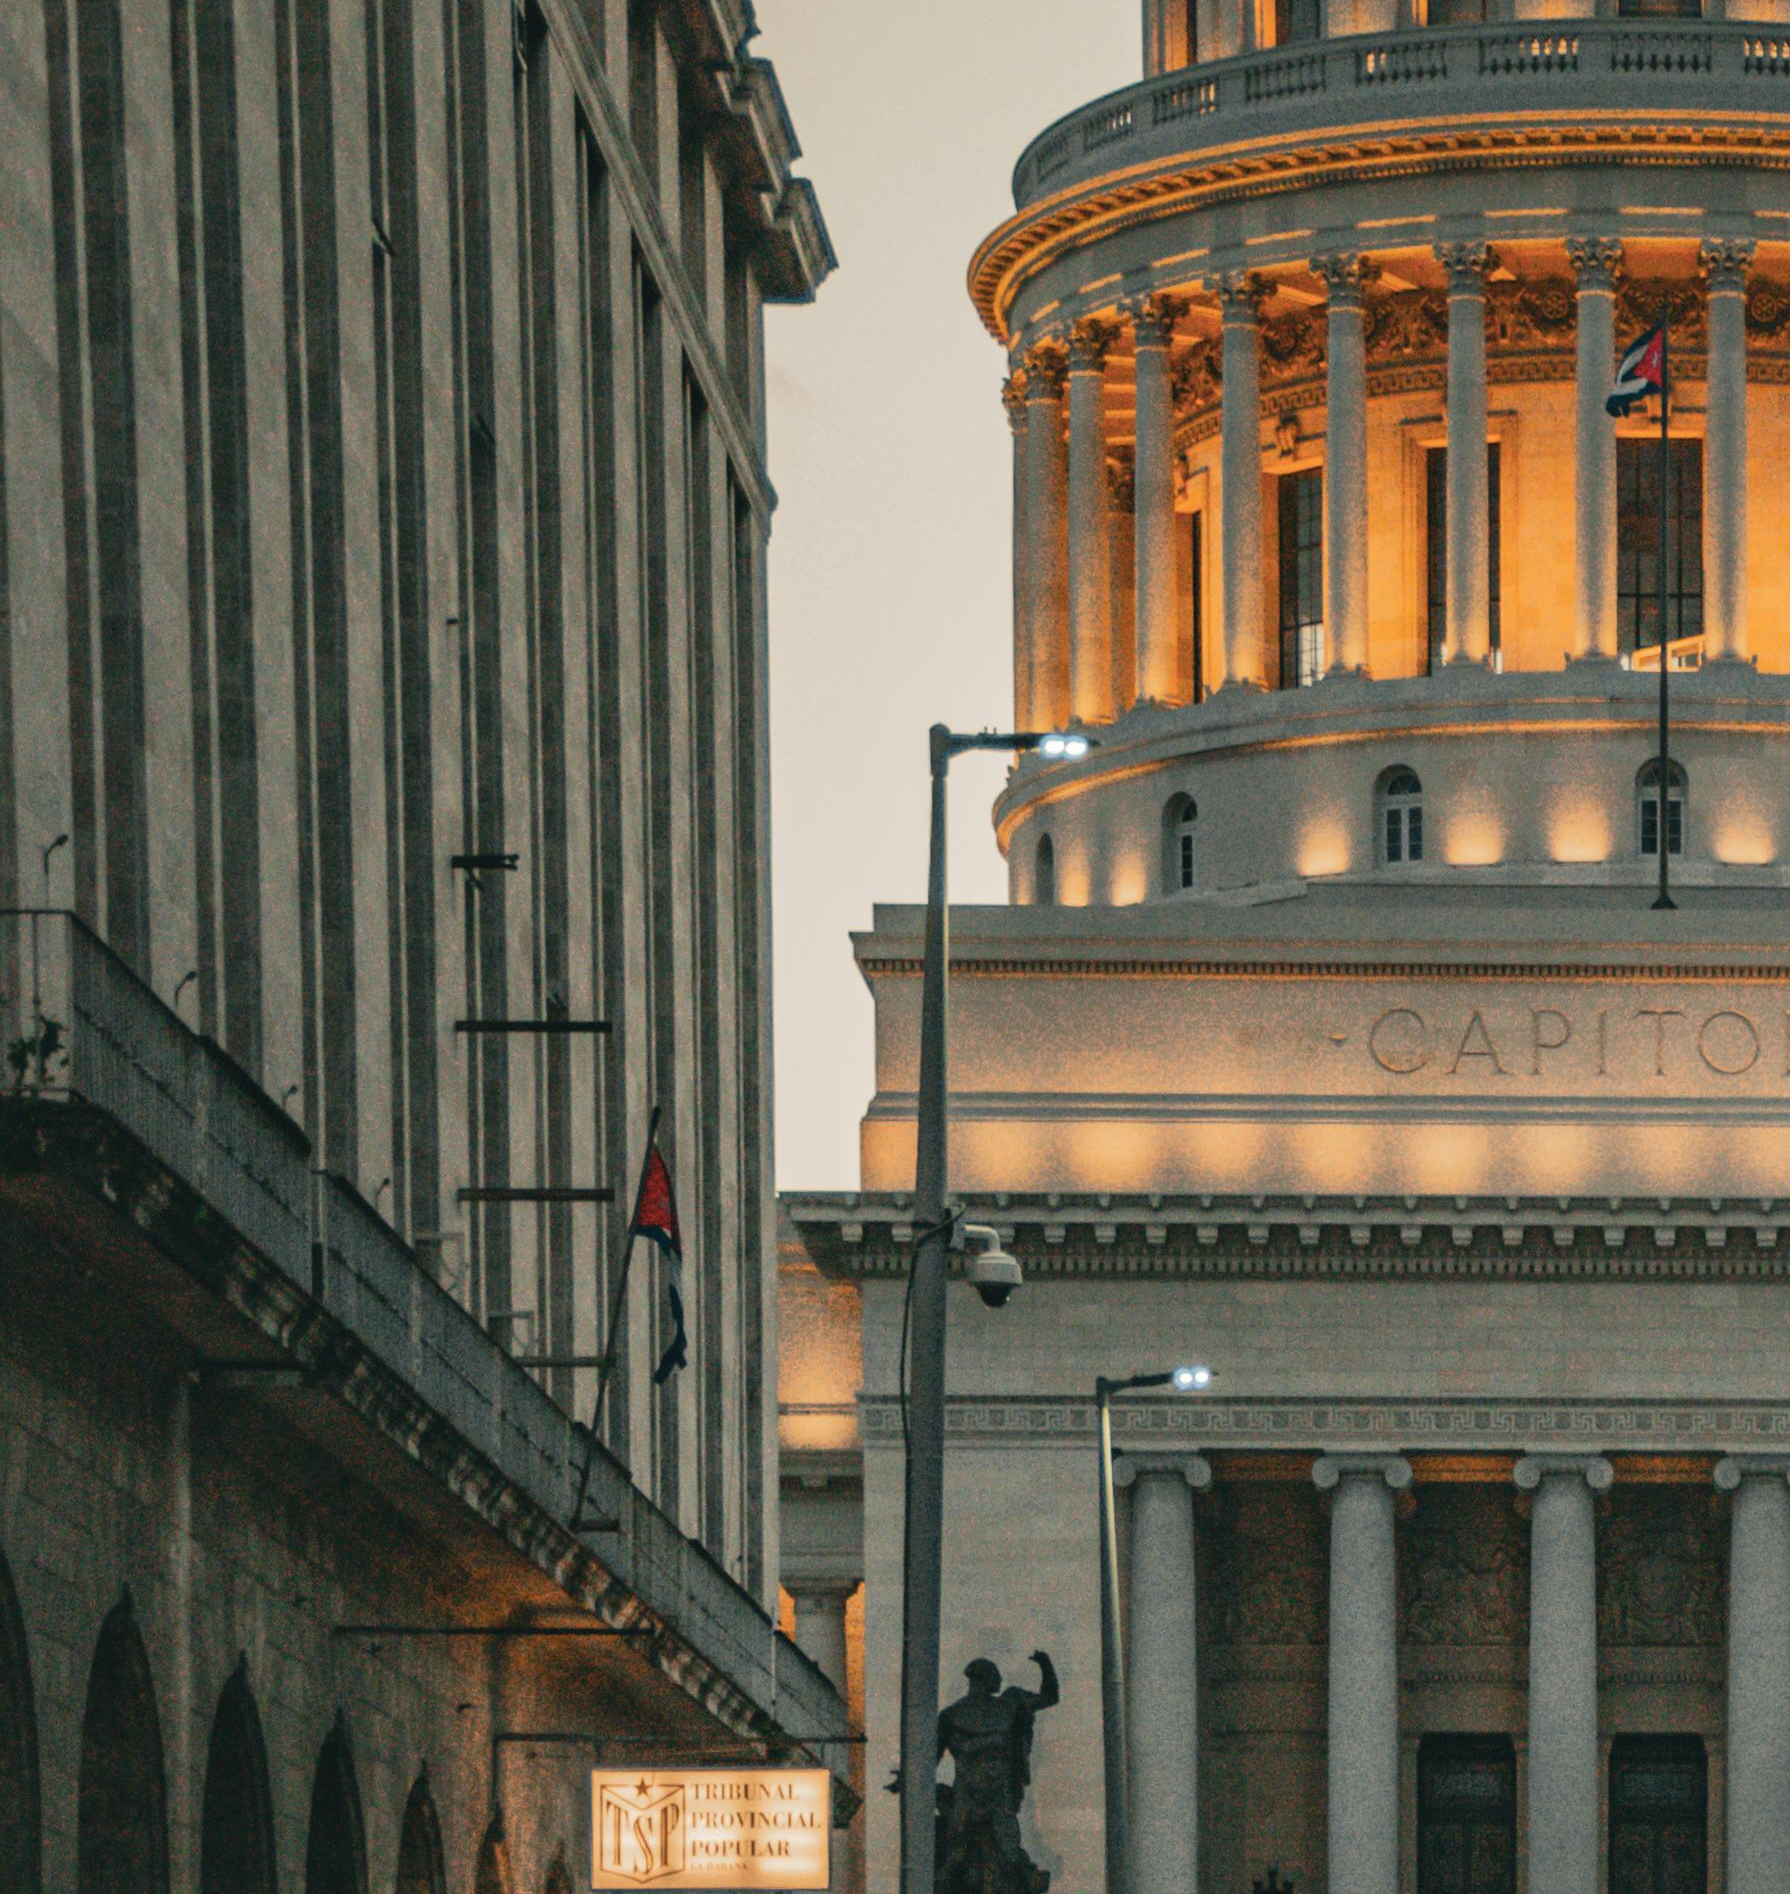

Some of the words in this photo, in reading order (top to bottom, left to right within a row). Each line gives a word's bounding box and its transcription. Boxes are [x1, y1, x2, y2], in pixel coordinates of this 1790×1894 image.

[690, 1783, 800, 1801] TRIBUNAL
[691, 1811, 821, 1828] PROVINCIAL
[691, 1840, 790, 1857] POPULAR
